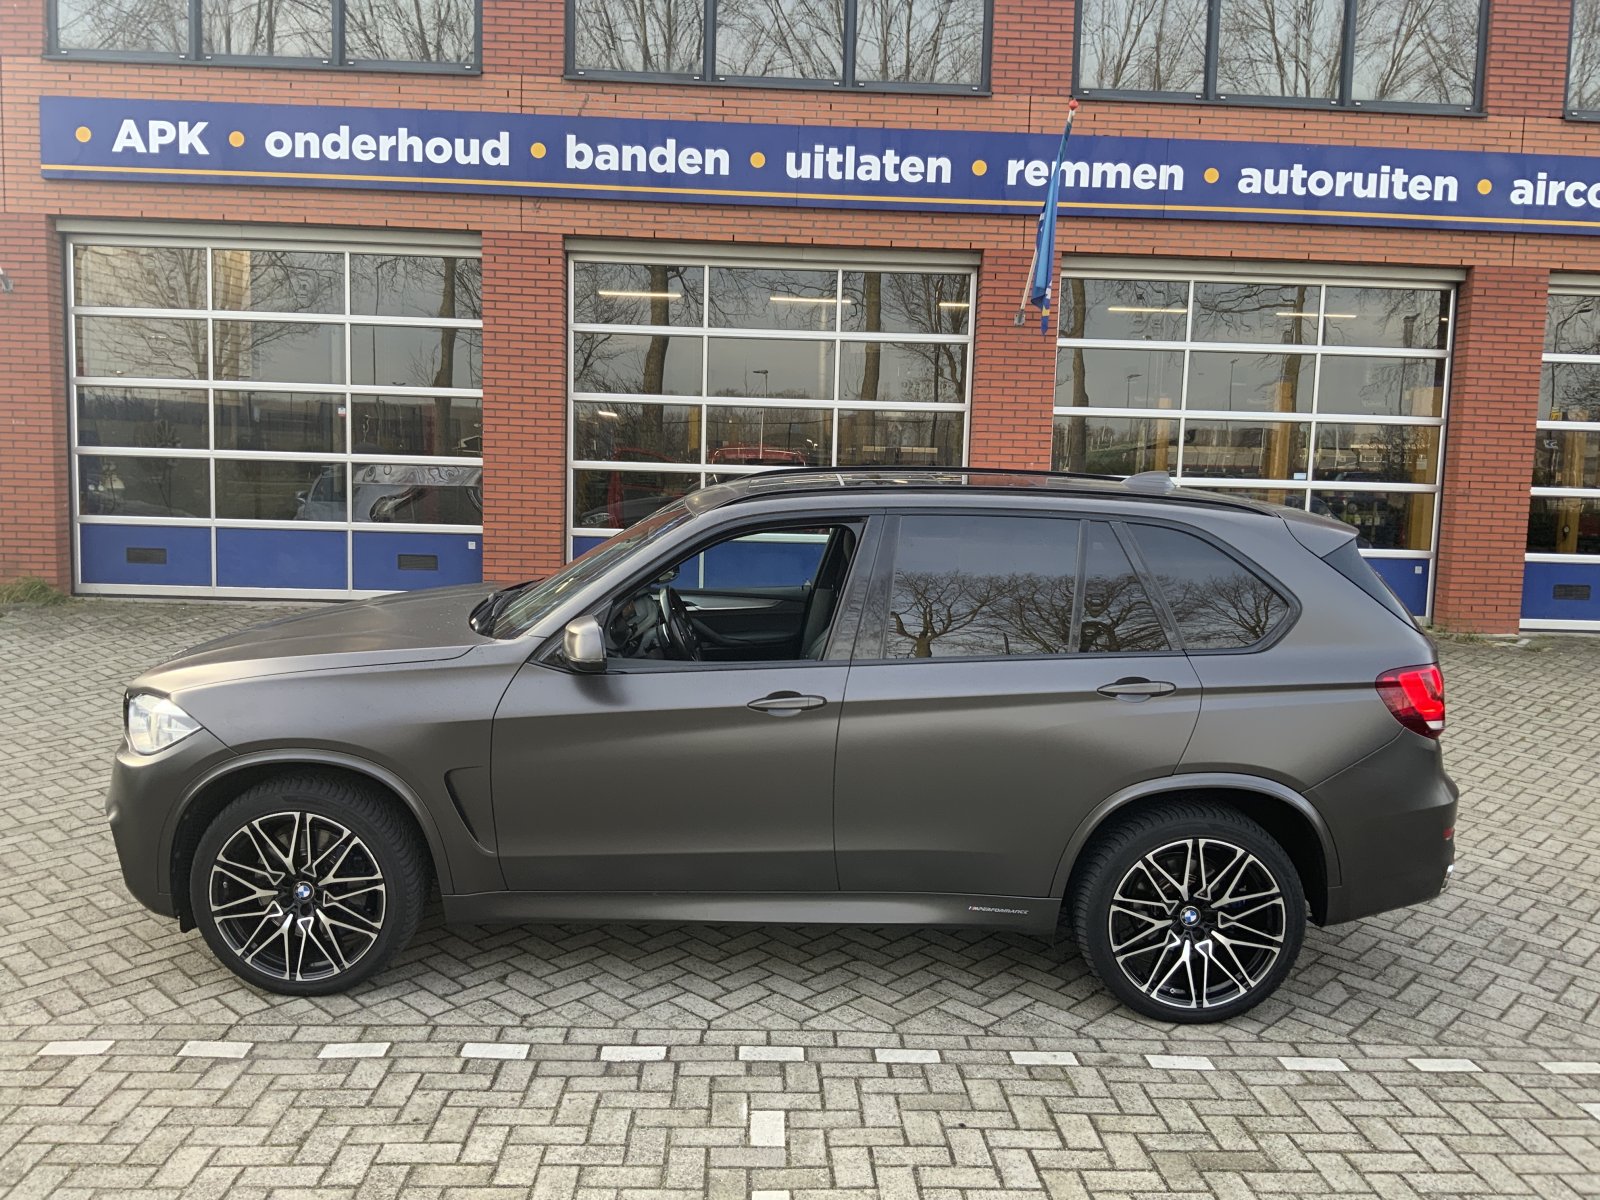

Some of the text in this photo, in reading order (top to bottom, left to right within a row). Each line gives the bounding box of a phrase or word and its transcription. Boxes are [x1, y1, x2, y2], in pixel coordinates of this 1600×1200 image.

[111, 118, 209, 156] APK
[264, 124, 510, 166] onderhoud
[566, 133, 731, 176] banden
[785, 145, 952, 184] uitlaten
[1006, 159, 1184, 191] remmen
[1237, 164, 1459, 202] autoruiten
